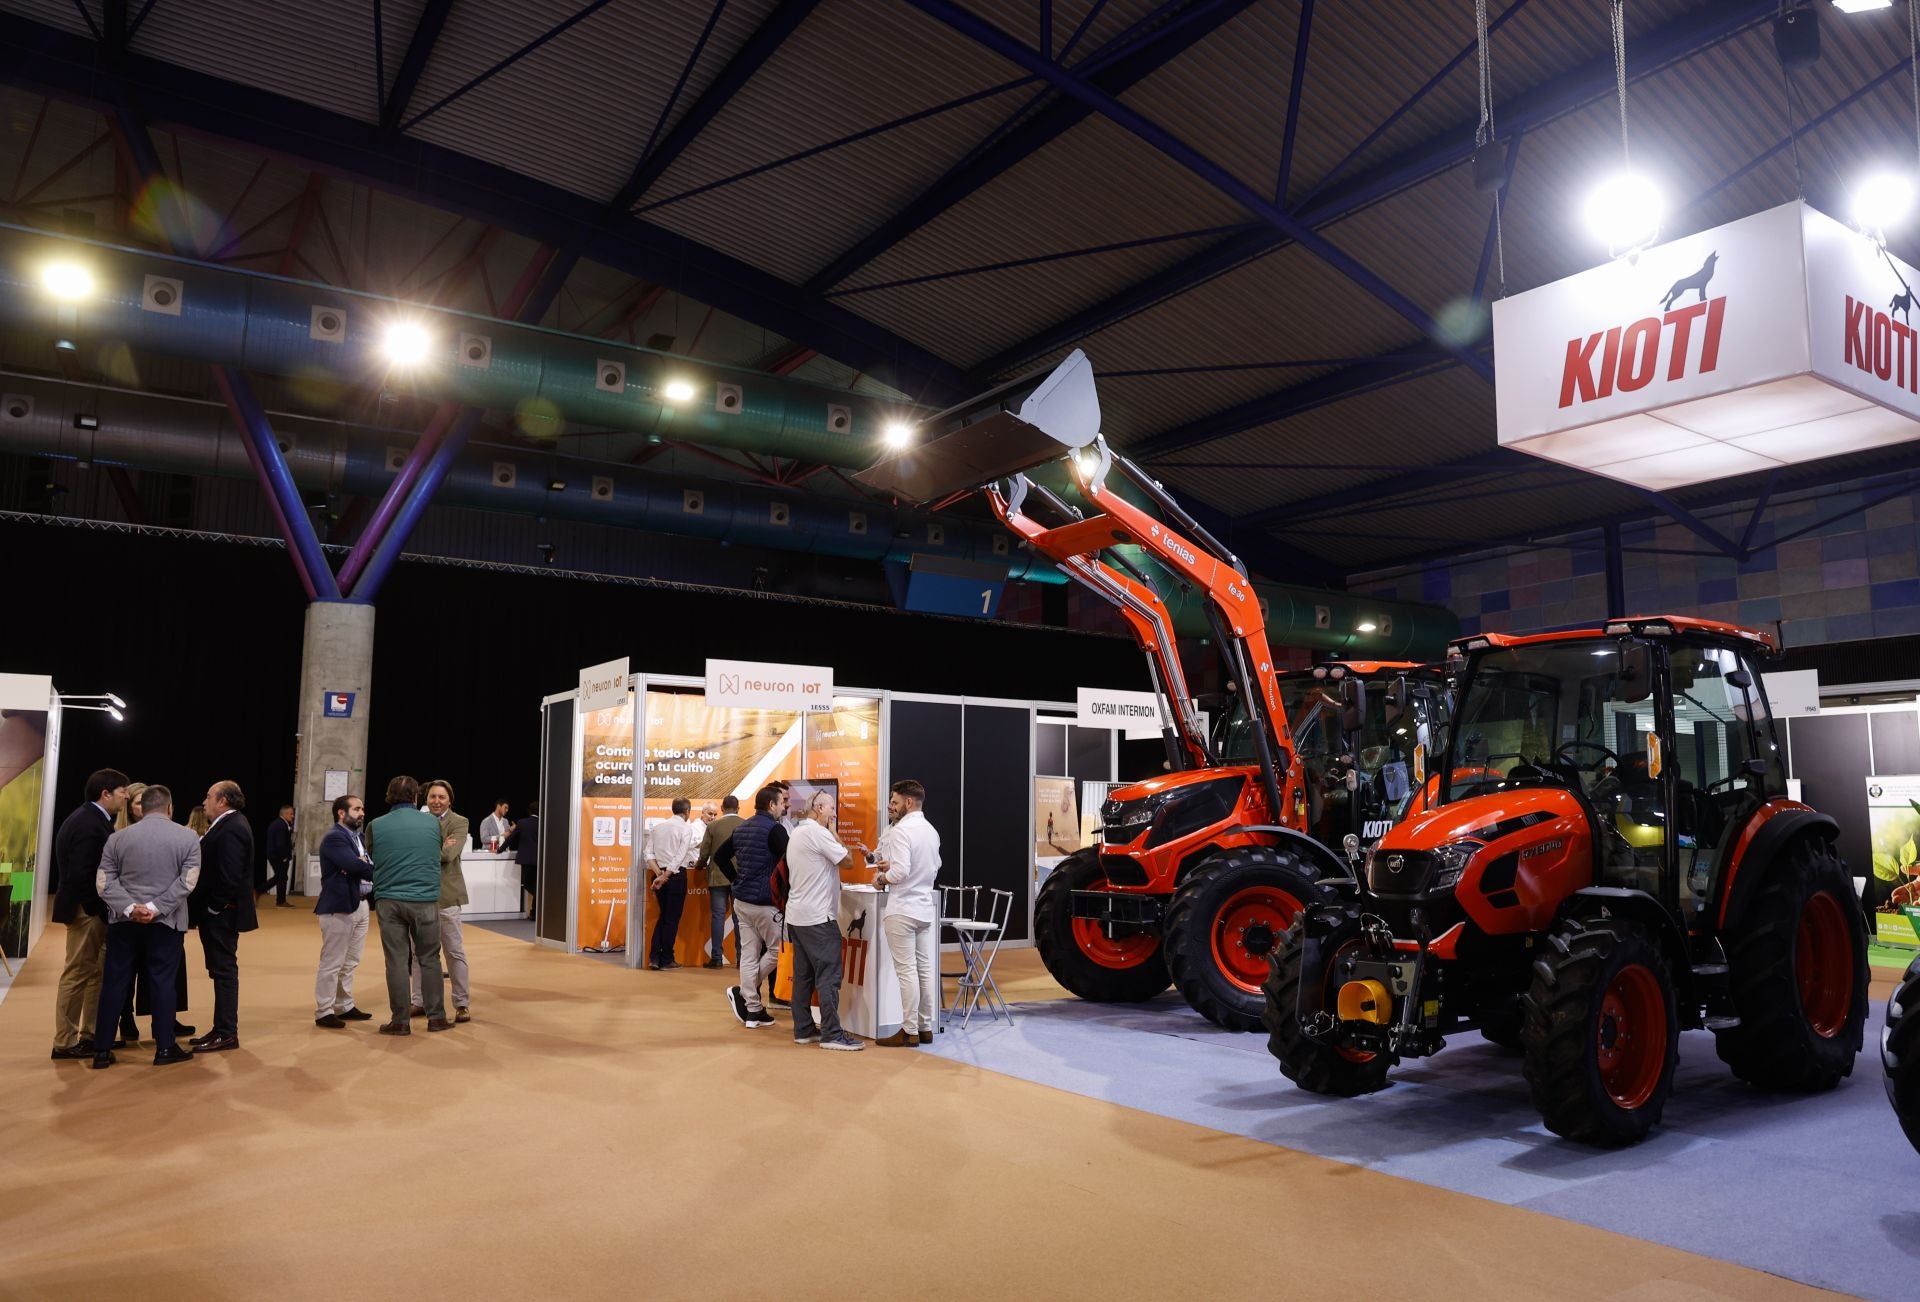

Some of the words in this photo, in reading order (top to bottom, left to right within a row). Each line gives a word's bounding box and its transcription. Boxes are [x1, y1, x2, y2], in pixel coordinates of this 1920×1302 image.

[1558, 295, 1727, 409] KIOTI
[1844, 294, 1918, 395] KIOTI
[1162, 533, 1196, 565] tenias
[981, 589, 992, 614] 1
[591, 680, 612, 693] neuron
[613, 676, 622, 688] IoT
[744, 680, 794, 693] neuron
[802, 682, 821, 694] IoT
[1091, 702, 1117, 715] OXFAM
[1117, 704, 1155, 718] INTERMON
[653, 747, 682, 759] todo
[684, 748, 696, 759] lo
[697, 750, 721, 761] que
[657, 761, 671, 772] tu
[673, 761, 714, 773] cultivo
[594, 773, 633, 785] desde
[650, 775, 682, 786] nube
